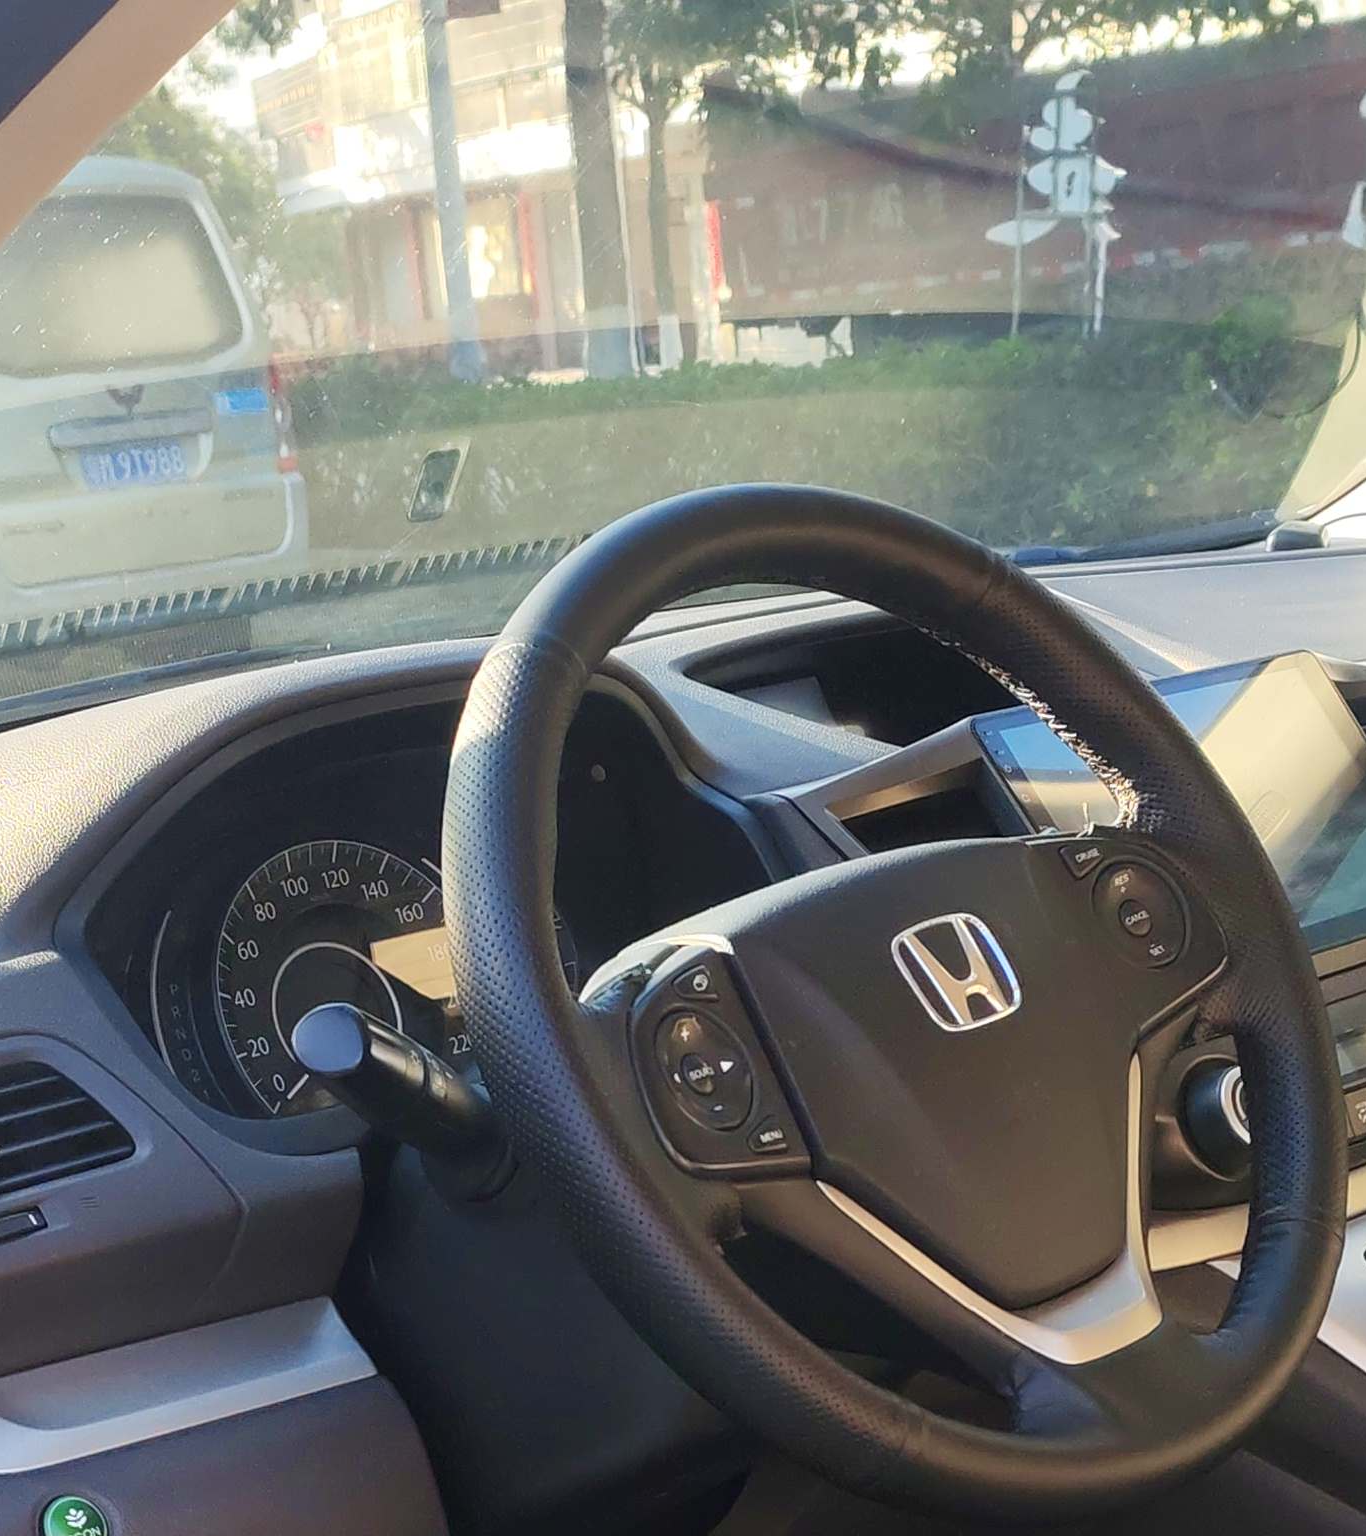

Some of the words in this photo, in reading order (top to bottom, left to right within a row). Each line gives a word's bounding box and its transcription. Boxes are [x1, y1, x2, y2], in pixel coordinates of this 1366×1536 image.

[280, 876, 309, 898] 100
[321, 868, 350, 888] 120
[360, 880, 389, 901] 140
[254, 901, 276, 922] 80
[395, 902, 424, 924] 160
[237, 939, 260, 961] 60
[235, 987, 256, 1009] 40
[247, 1036, 270, 1058] 20
[272, 1073, 285, 1092] 0
